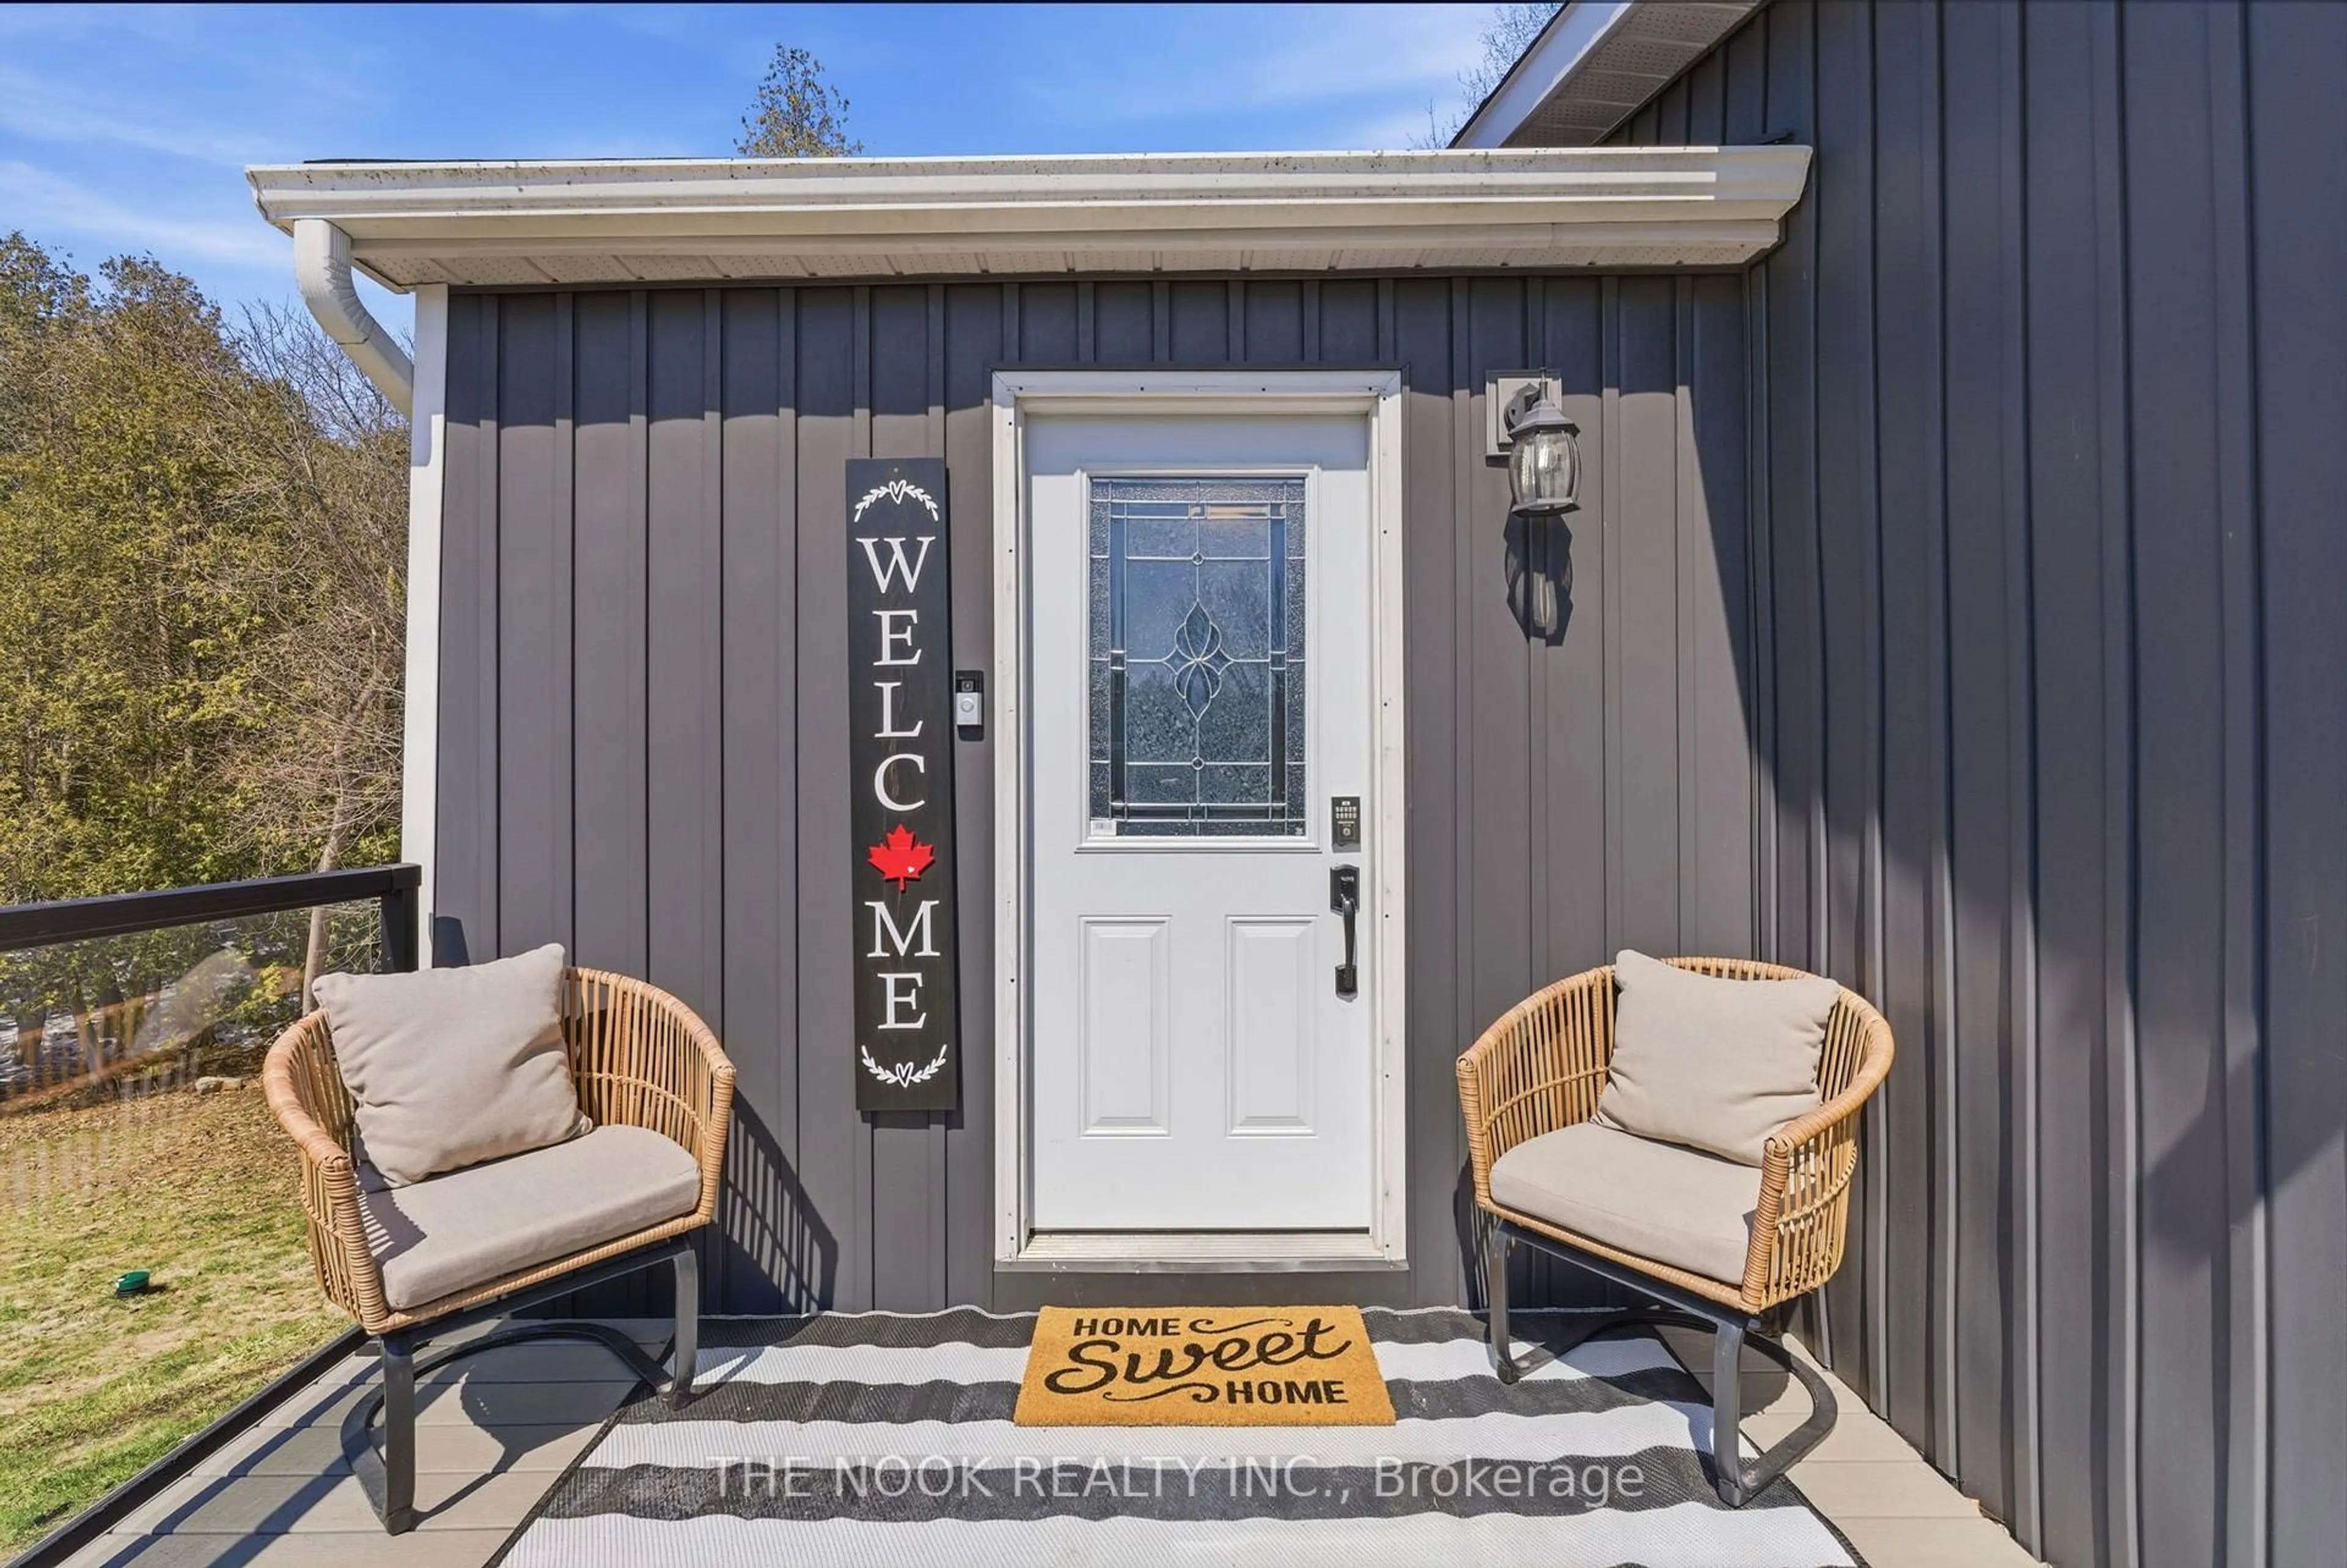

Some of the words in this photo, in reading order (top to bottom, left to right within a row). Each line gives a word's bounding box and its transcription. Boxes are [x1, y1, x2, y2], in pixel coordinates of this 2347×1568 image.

[856, 535, 941, 1030] WELCME
[1073, 1317, 1181, 1336] HOME
[1044, 1317, 1352, 1394] Sweet
[1226, 1380, 1348, 1404] HOME
